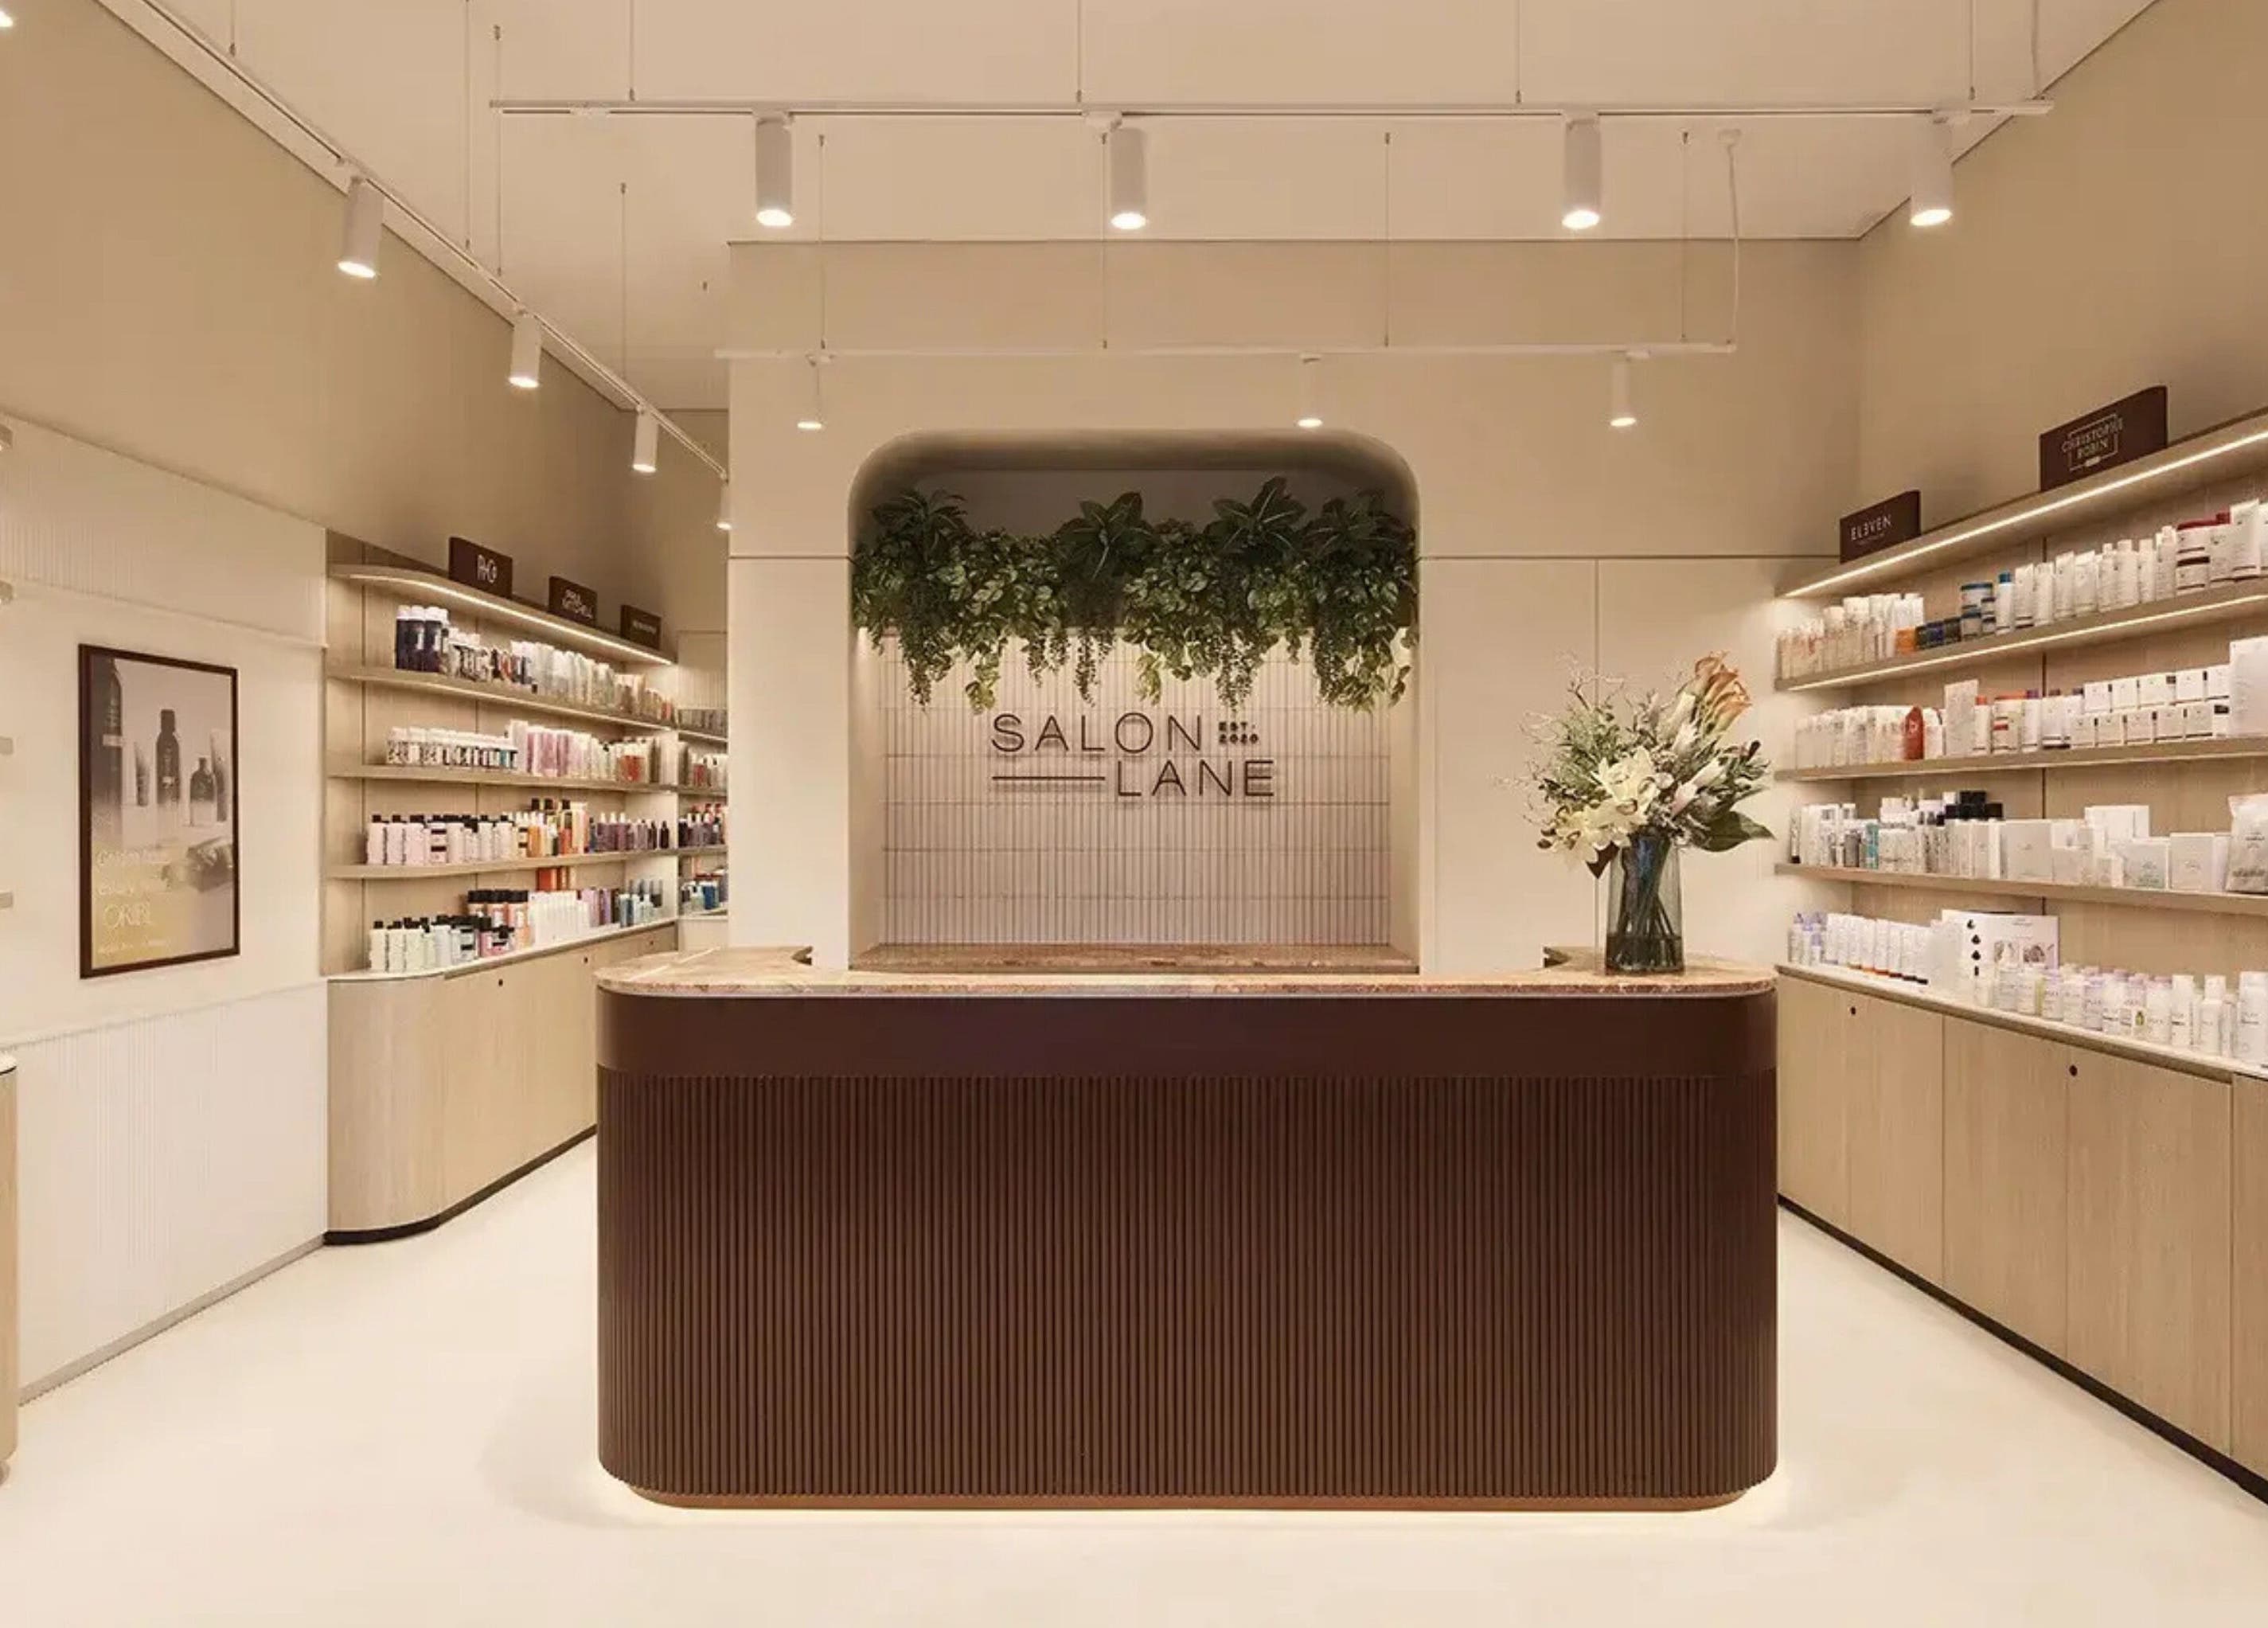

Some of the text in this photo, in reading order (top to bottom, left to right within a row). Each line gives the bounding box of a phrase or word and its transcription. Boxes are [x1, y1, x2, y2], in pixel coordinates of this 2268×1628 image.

[991, 712, 1202, 754] SALON
[1218, 732, 1259, 745] 2020
[1117, 759, 1275, 797] LANE
